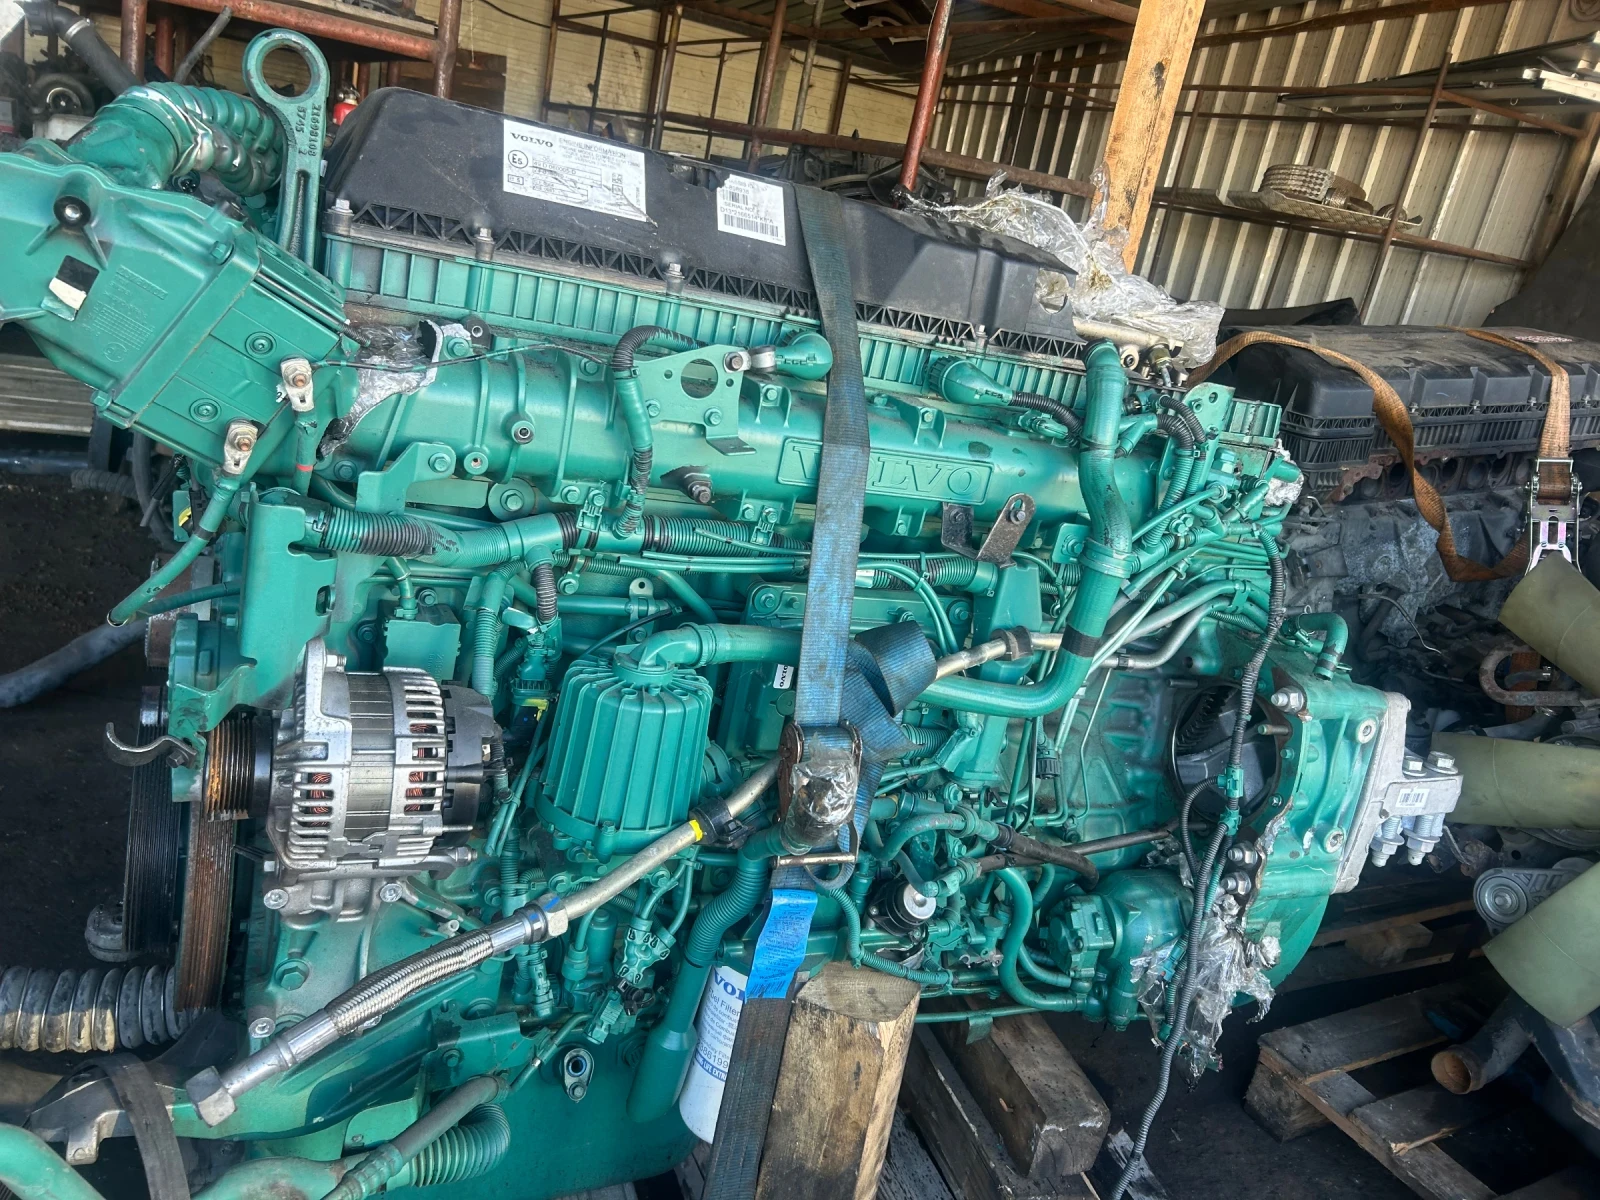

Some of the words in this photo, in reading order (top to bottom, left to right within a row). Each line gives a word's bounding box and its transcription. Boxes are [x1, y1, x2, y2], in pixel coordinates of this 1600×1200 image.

[510, 132, 554, 148] VOLVO
[724, 201, 744, 211] SERIAL
[792, 445, 981, 496] VLVO
[720, 1000, 741, 1017] Filter
